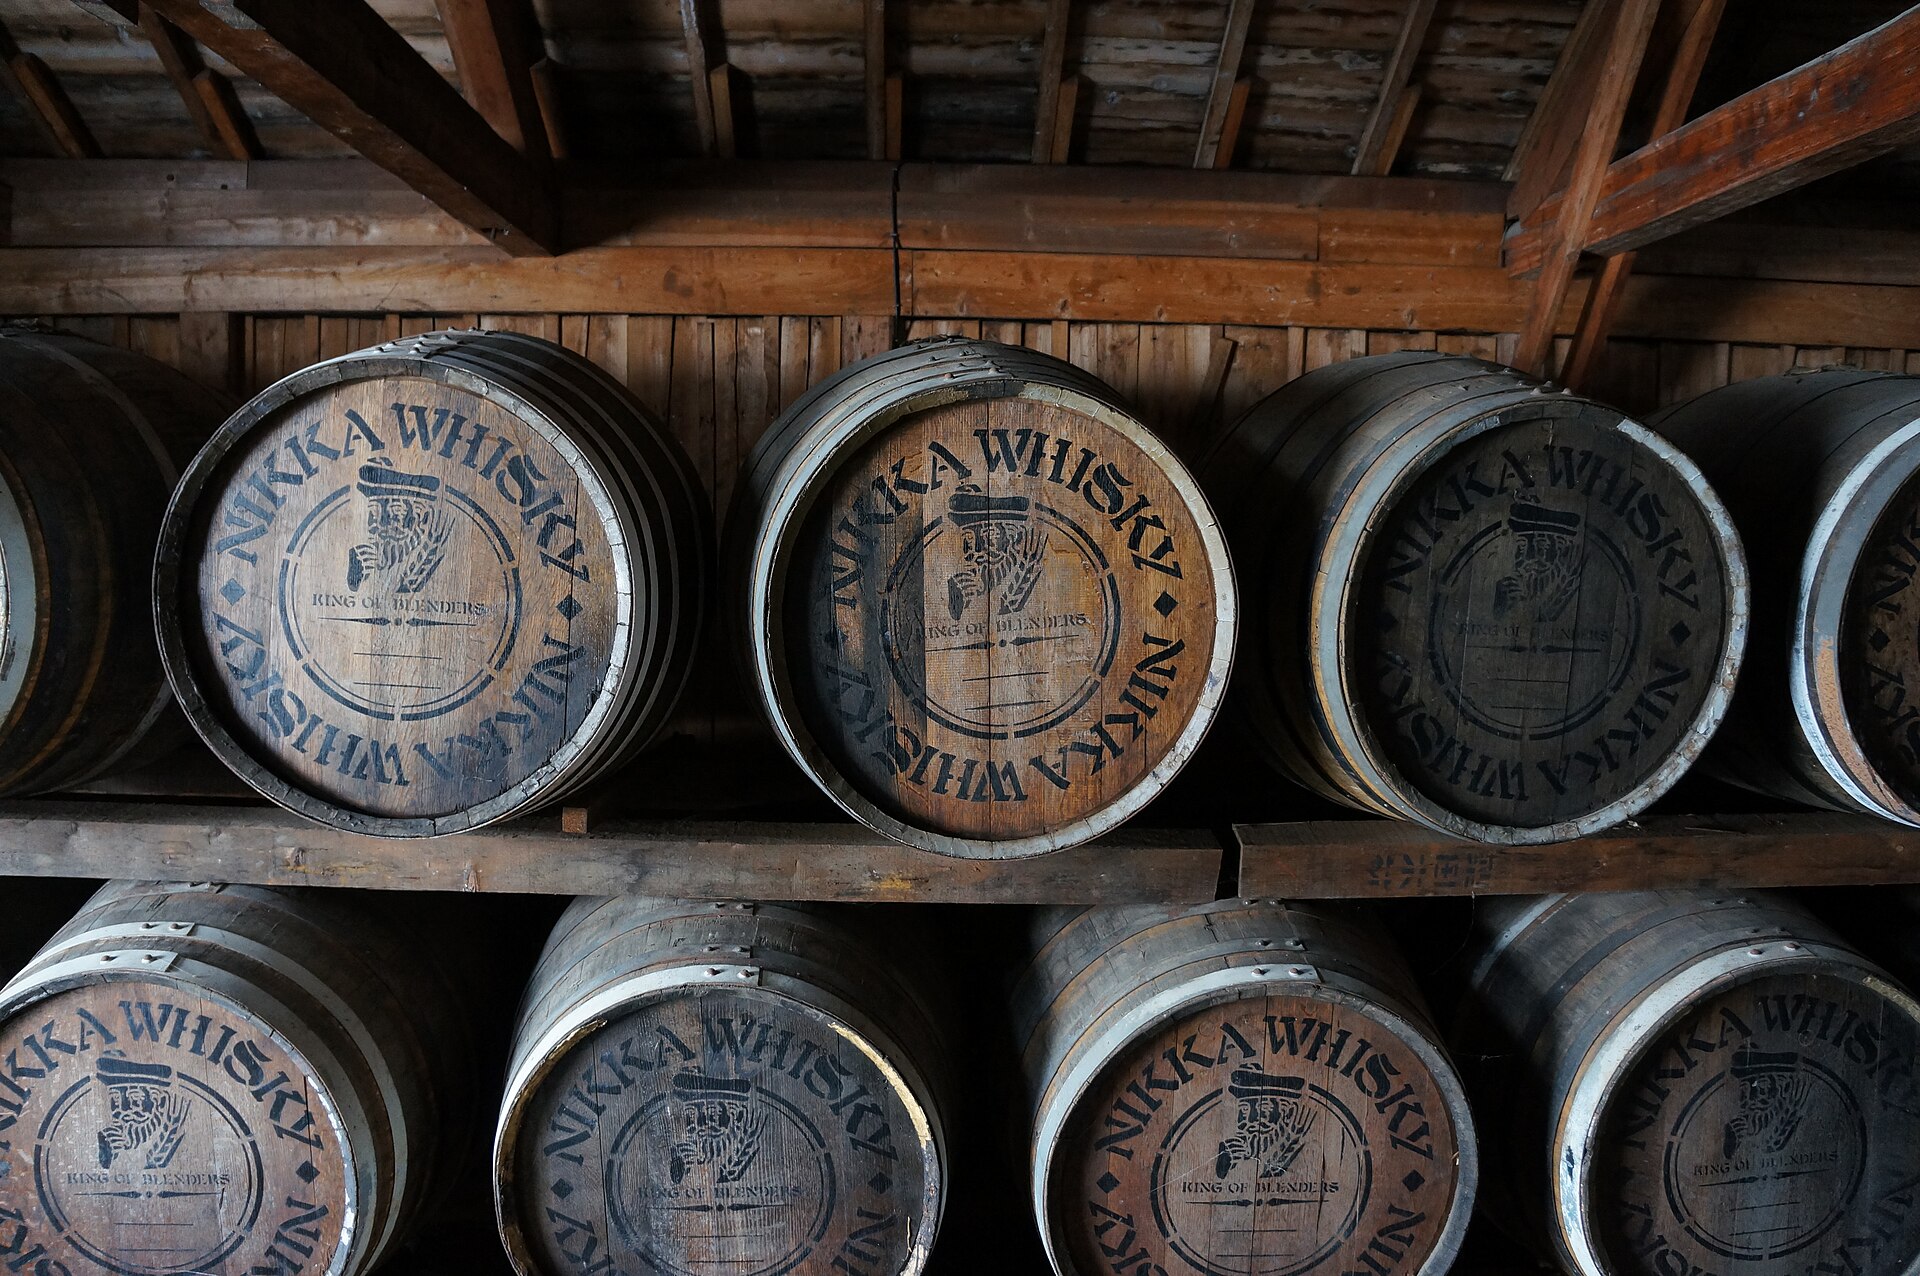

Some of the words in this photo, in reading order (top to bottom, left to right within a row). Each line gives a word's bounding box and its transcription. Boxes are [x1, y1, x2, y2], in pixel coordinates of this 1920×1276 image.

[216, 408, 385, 567] NIKKA
[390, 402, 591, 584] WHISKY
[973, 428, 1183, 580] WHISKY
[1383, 450, 1536, 594] NIKKA
[1543, 445, 1700, 611] WHISKY
[312, 593, 356, 608] KING
[362, 596, 384, 610] OF
[392, 598, 486, 616] BLENDERS
[917, 624, 960, 640] ING
[965, 621, 988, 636] OF
[996, 613, 1086, 632] BLENDERS
[211, 611, 410, 787] WHISKY
[823, 664, 1028, 802] WHISKY
[1028, 632, 1185, 790] NIKKA
[1537, 656, 1691, 797] NIKKA
[118, 1001, 324, 1150] WHISKY
[543, 1024, 695, 1166] NIKKA
[703, 1016, 899, 1162] WHISKY
[1094, 1022, 1256, 1161] NIKKA
[1263, 1015, 1434, 1160] WHISKY
[67, 1173, 109, 1185] KING
[142, 1173, 230, 1186] BLENDERS
[1182, 1181, 1223, 1193] KING
[1228, 1181, 1248, 1193] OF
[1256, 1181, 1339, 1193] BLENDERS
